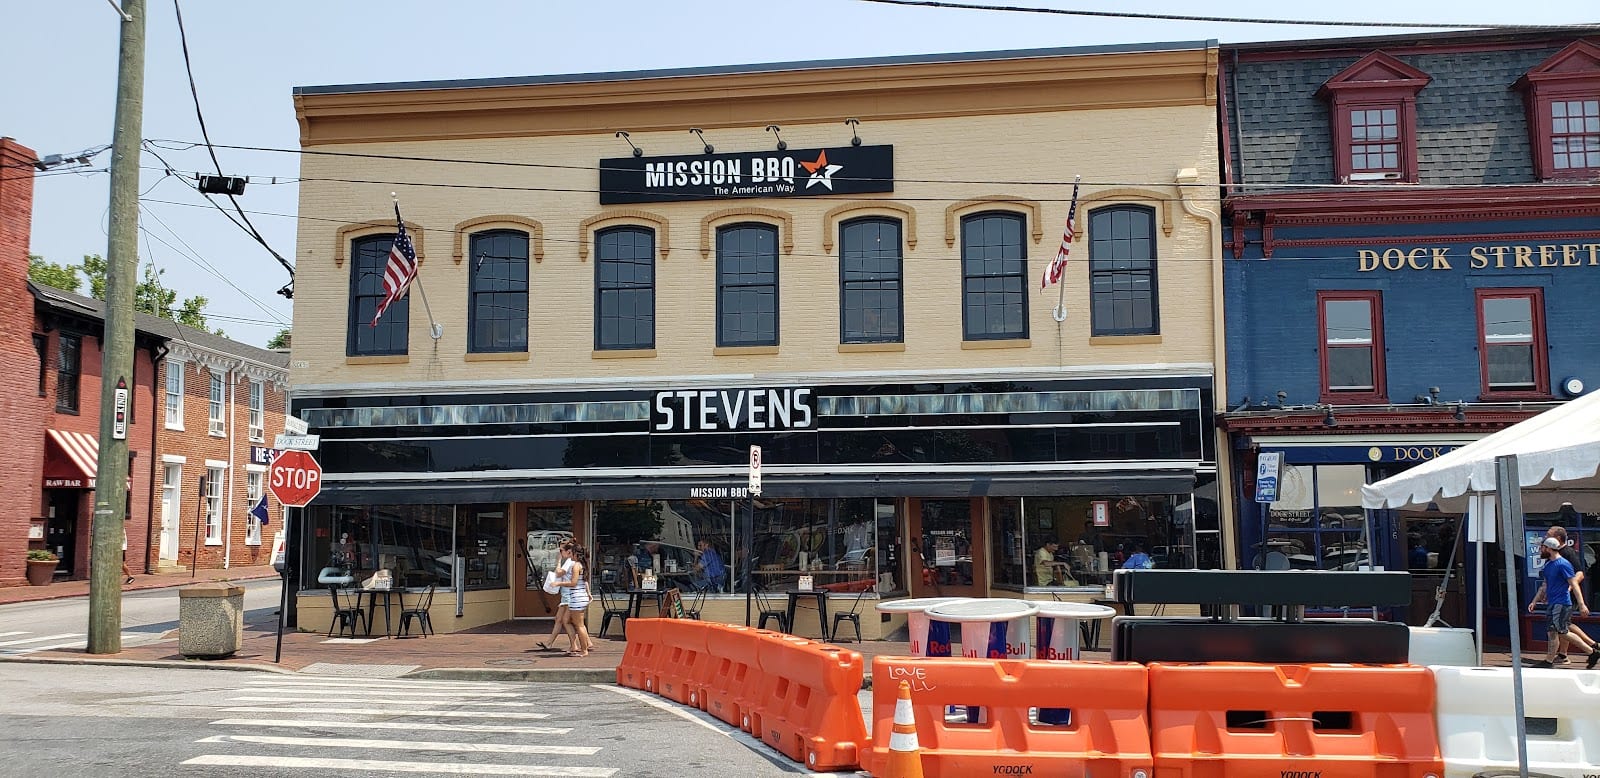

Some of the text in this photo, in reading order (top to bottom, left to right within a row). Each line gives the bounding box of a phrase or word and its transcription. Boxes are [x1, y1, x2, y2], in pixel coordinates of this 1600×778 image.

[645, 156, 795, 187] MISSION BBQ
[713, 183, 796, 195] The American Way.
[1358, 243, 1600, 272] DOCK STREET
[116, 392, 126, 413] KIND
[655, 388, 812, 431] STEVENS
[294, 438, 316, 446] STREET
[1395, 446, 1443, 462] DOCK
[46, 479, 64, 487] RAW
[64, 479, 81, 487] BAR
[272, 465, 318, 492] STOP
[690, 487, 748, 499] MISSION BBQ
[1289, 510, 1311, 518] STREET
[1047, 647, 1073, 661] Bull
[888, 665, 927, 680] LOVE
[992, 765, 1033, 775] YODOCK
